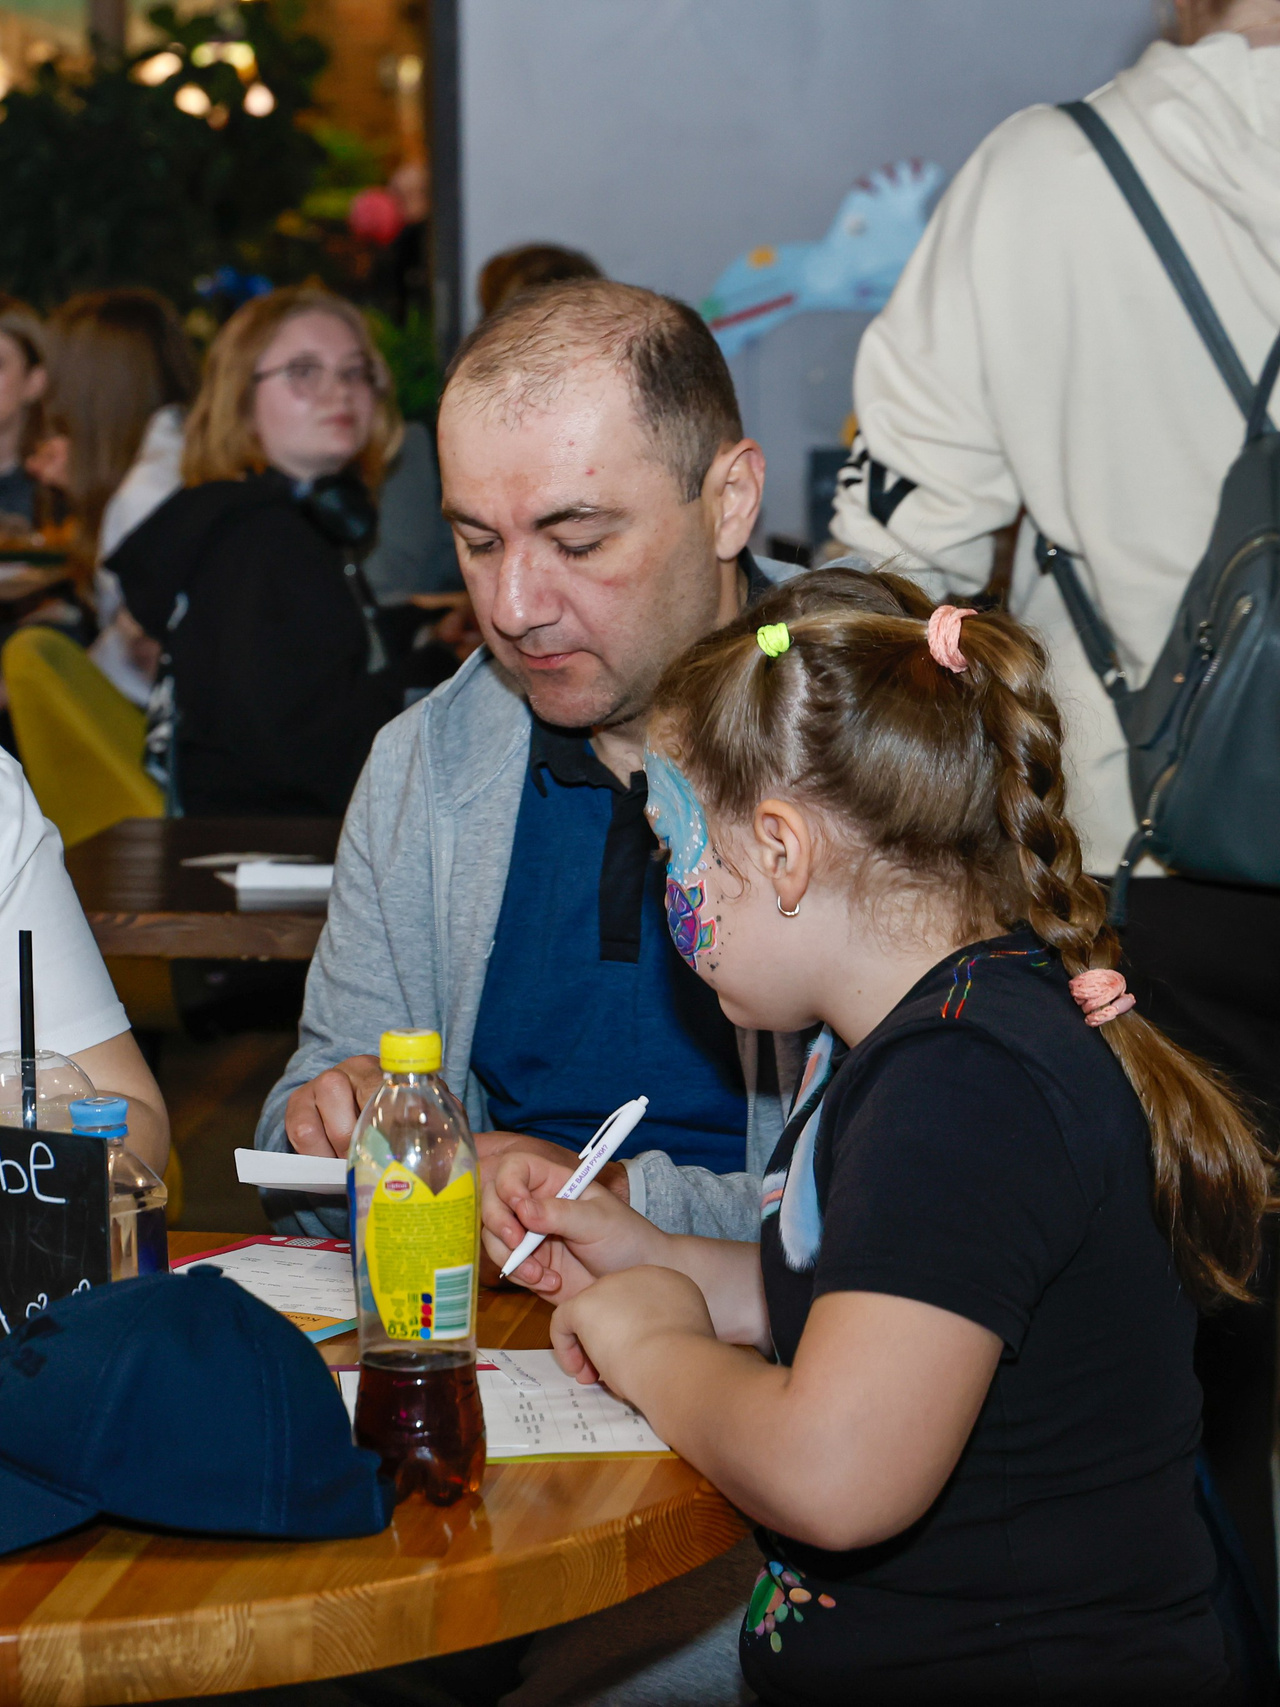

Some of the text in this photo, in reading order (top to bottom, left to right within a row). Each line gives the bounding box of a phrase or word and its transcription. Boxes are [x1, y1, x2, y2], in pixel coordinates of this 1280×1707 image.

[567, 1183, 578, 1194] ЖЕ
[575, 1165, 592, 1184] ВАШИ
[588, 1144, 609, 1167] РУЧКИ?
